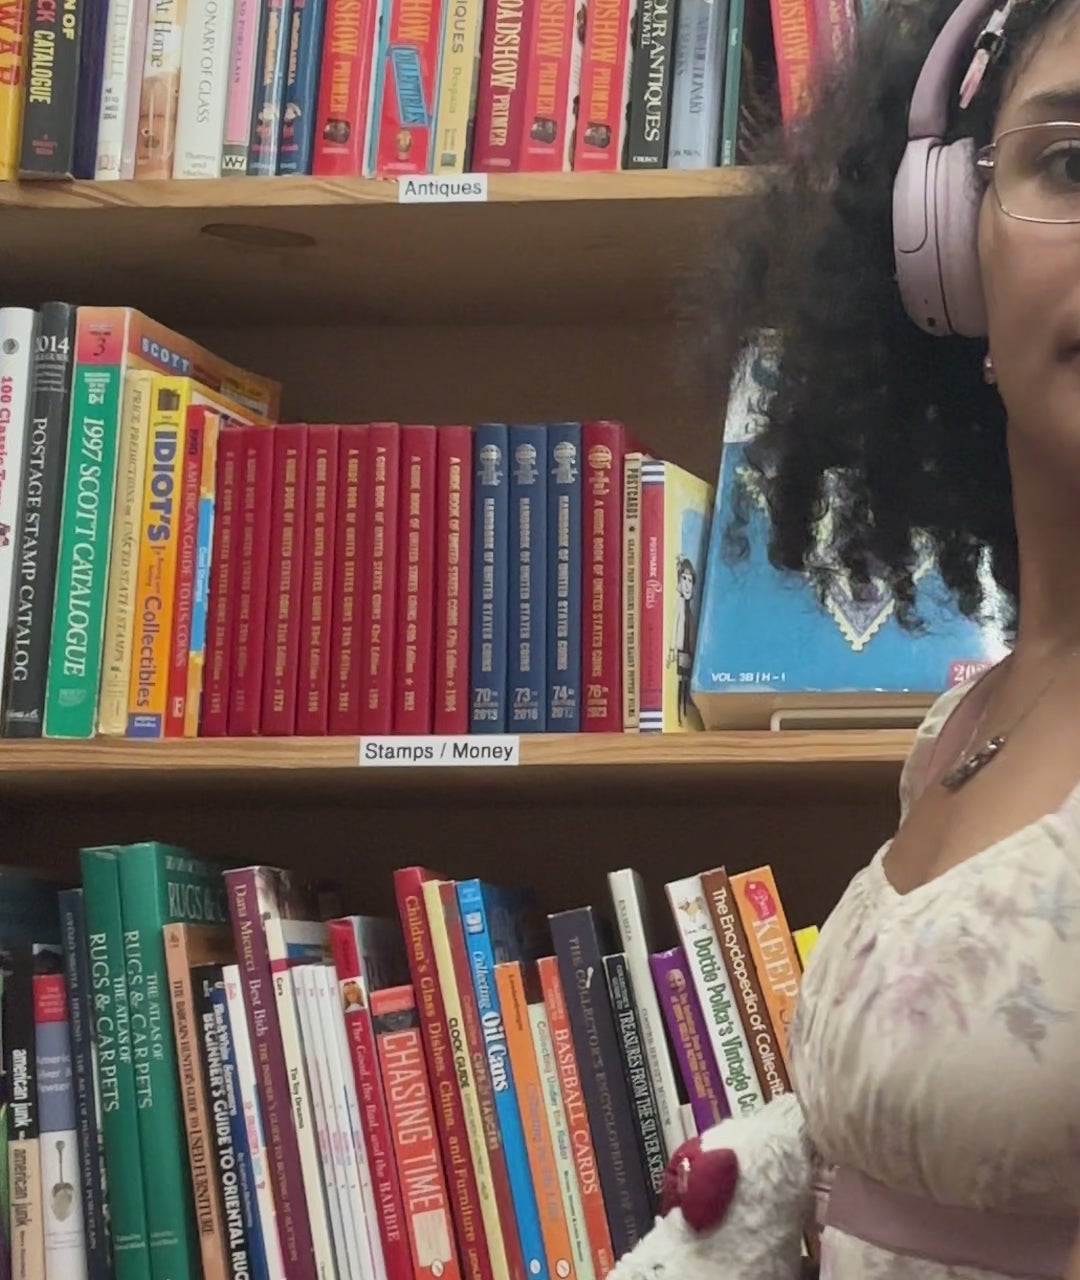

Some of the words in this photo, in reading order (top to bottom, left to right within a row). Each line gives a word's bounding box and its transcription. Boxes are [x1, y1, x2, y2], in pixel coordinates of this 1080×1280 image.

[62, 16, 77, 41] OF
[151, 20, 172, 68] Home
[29, 30, 55, 105] CATALOGUE
[200, 56, 215, 79] OF
[643, 42, 667, 142] ANTIQUES
[197, 82, 213, 124] GLASS
[489, 94, 510, 147] PRIMER
[404, 181, 482, 198] Antiques
[141, 336, 191, 374] SCOTT
[27, 417, 48, 508] POSTAGE
[82, 416, 105, 463] 1997
[75, 463, 102, 541] SCOTT
[21, 512, 41, 581] STAMP
[13, 584, 36, 682] CATALOG
[64, 543, 95, 677] CATALOGUE
[136, 596, 163, 708] Collectibles
[711, 672, 736, 683] VOL.
[365, 742, 434, 762] Stamps
[439, 742, 447, 759] /
[452, 742, 514, 762] Money
[233, 884, 248, 919] Dana
[712, 886, 729, 915] The
[89, 932, 110, 989] RUGS
[124, 930, 144, 987] RUGS
[404, 894, 429, 974] Children's
[420, 974, 436, 1018] Glass
[471, 950, 492, 1010] Collecting
[718, 914, 755, 1013] Encyclopedia
[752, 920, 800, 999] KEEP
[94, 992, 112, 1009] &
[112, 974, 124, 998] THE
[129, 991, 146, 1008] &
[248, 978, 263, 1007] Best
[114, 1000, 130, 1046] ATLAS
[252, 1007, 269, 1038] Bids
[449, 1016, 464, 1052] CLOCK
[481, 1011, 504, 1044] Oil
[693, 936, 717, 983] Dottie
[706, 982, 735, 1039] Polka's
[721, 1039, 749, 1095] Vintage
[96, 1015, 120, 1113] CARPETS
[118, 1046, 132, 1065] OF
[131, 1013, 153, 1110] CARPETS
[202, 1012, 224, 1099] BEGINNER'S
[456, 1054, 470, 1088] GUIDE
[487, 1044, 509, 1092] Cans
[384, 1032, 434, 1145] CHASING
[555, 1028, 585, 1125] BASEBALL
[573, 1128, 598, 1195] CARDS
[213, 1102, 231, 1145] GUIDE
[12, 1148, 28, 1199] american
[219, 1148, 235, 1169] TO
[402, 1152, 445, 1212] TIME
[222, 1172, 244, 1250] ORIENTAL
[379, 1182, 401, 1242] BARBIE
